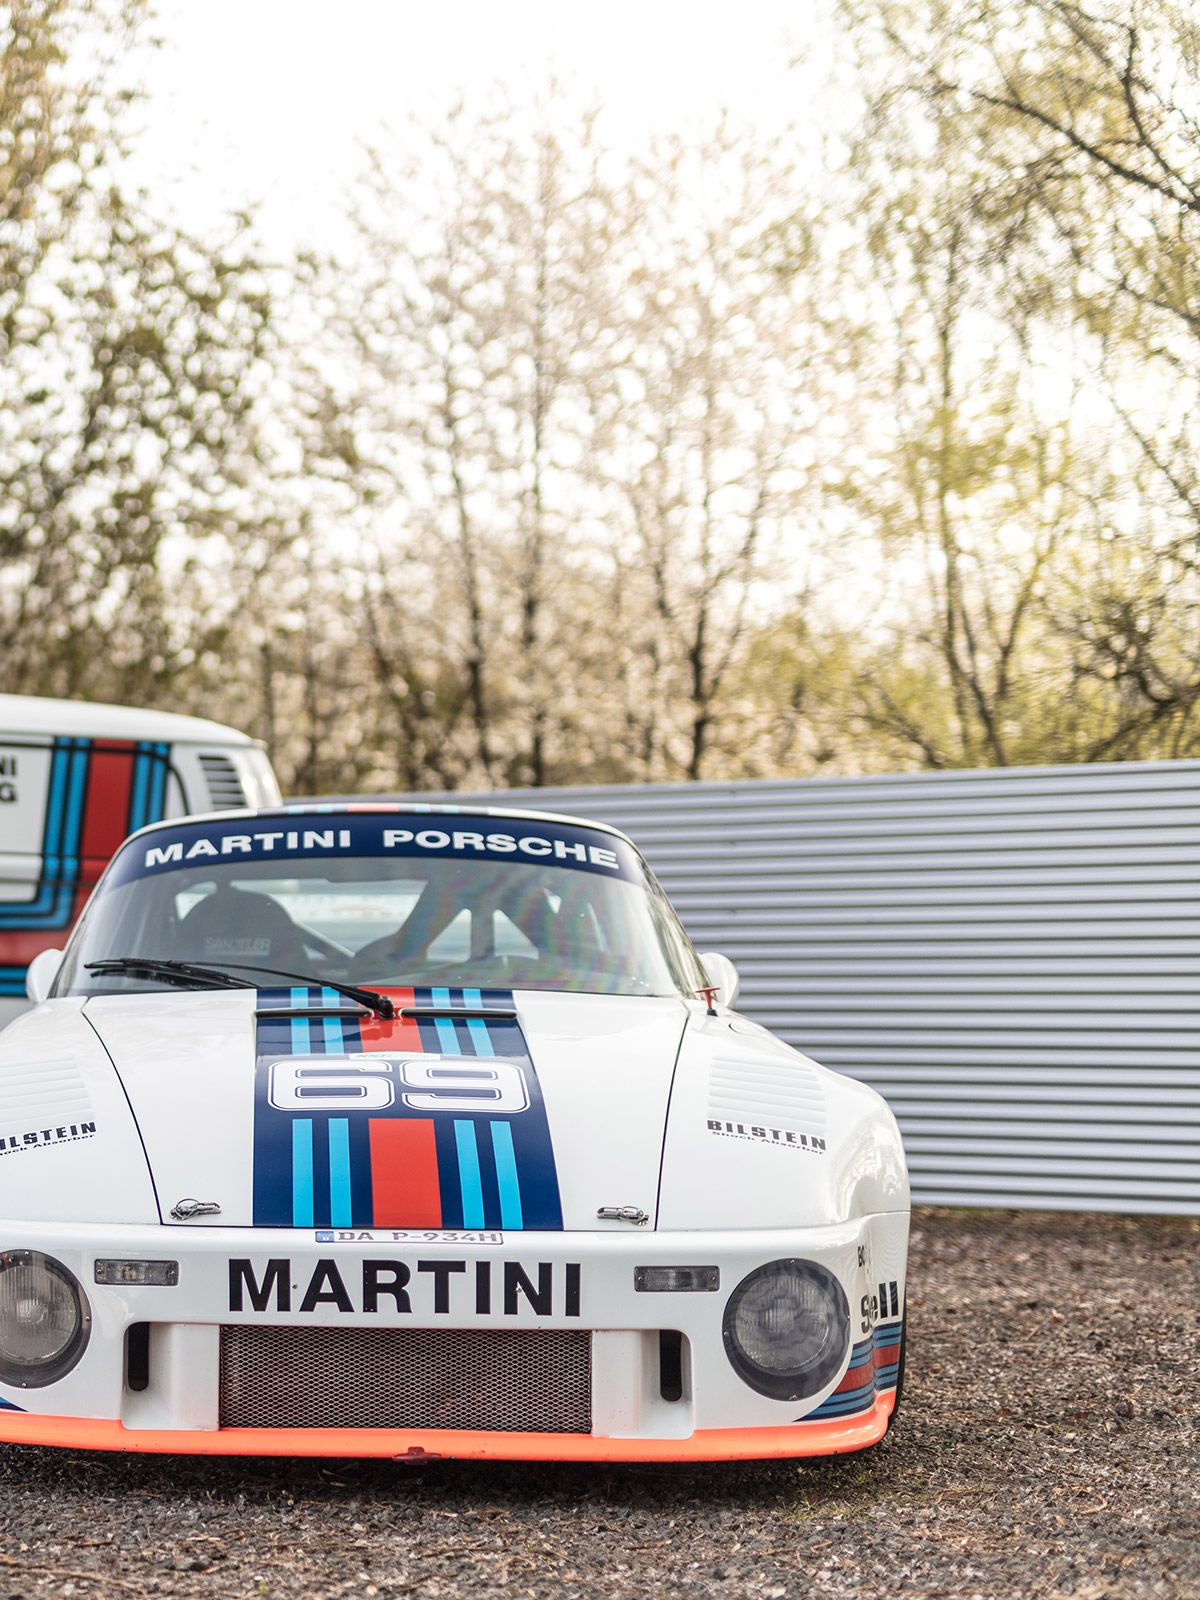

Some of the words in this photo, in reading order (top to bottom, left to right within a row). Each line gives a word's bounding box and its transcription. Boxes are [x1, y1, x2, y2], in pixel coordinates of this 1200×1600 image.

[144, 829, 351, 867] MARTINI
[384, 829, 619, 869] PORSCHE
[268, 1060, 531, 1113] 69
[33, 1134, 95, 1149] Absorber
[707, 1119, 826, 1151] BILSTEIN
[338, 1232, 375, 1241] DA
[392, 1232, 498, 1242] P-934H
[228, 1258, 582, 1317] MARTINI
